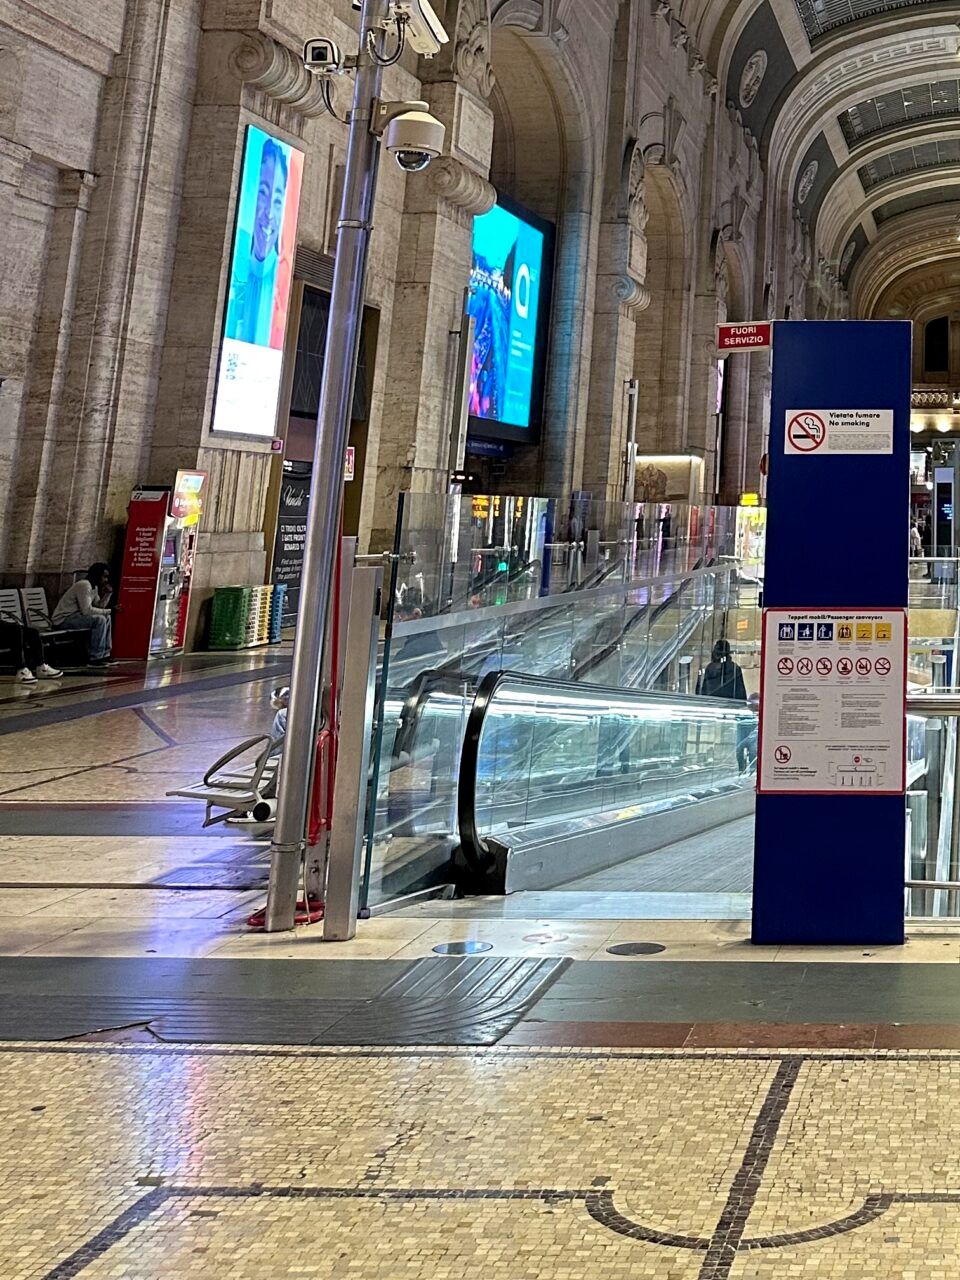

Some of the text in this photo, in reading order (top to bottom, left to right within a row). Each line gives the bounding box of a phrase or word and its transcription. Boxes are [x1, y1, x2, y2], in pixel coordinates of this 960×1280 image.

[730, 326, 757, 336] FUORI
[724, 335, 764, 346] SERVIZIO
[841, 420, 870, 428] smoking
